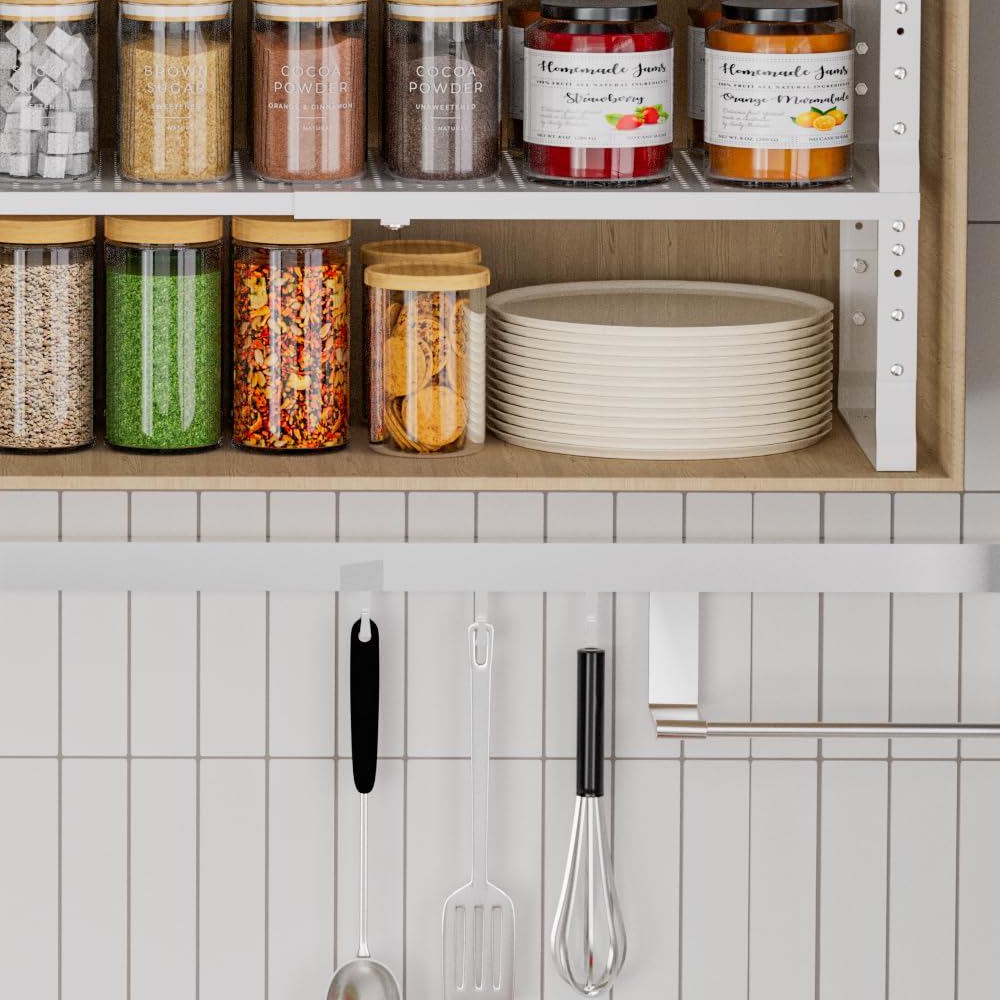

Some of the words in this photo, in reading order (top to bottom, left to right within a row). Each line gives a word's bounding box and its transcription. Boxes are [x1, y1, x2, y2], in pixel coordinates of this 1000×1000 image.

[281, 66, 340, 77] COCOA
[416, 66, 476, 77] COCOA
[537, 60, 628, 75] Homemade
[633, 63, 667, 77] Jams
[721, 62, 810, 78] Homemade
[814, 65, 848, 80] Jams
[274, 82, 348, 94] POWDER
[409, 82, 483, 94] POWDER
[564, 92, 646, 104] Strawberry
[720, 92, 768, 106] Orange
